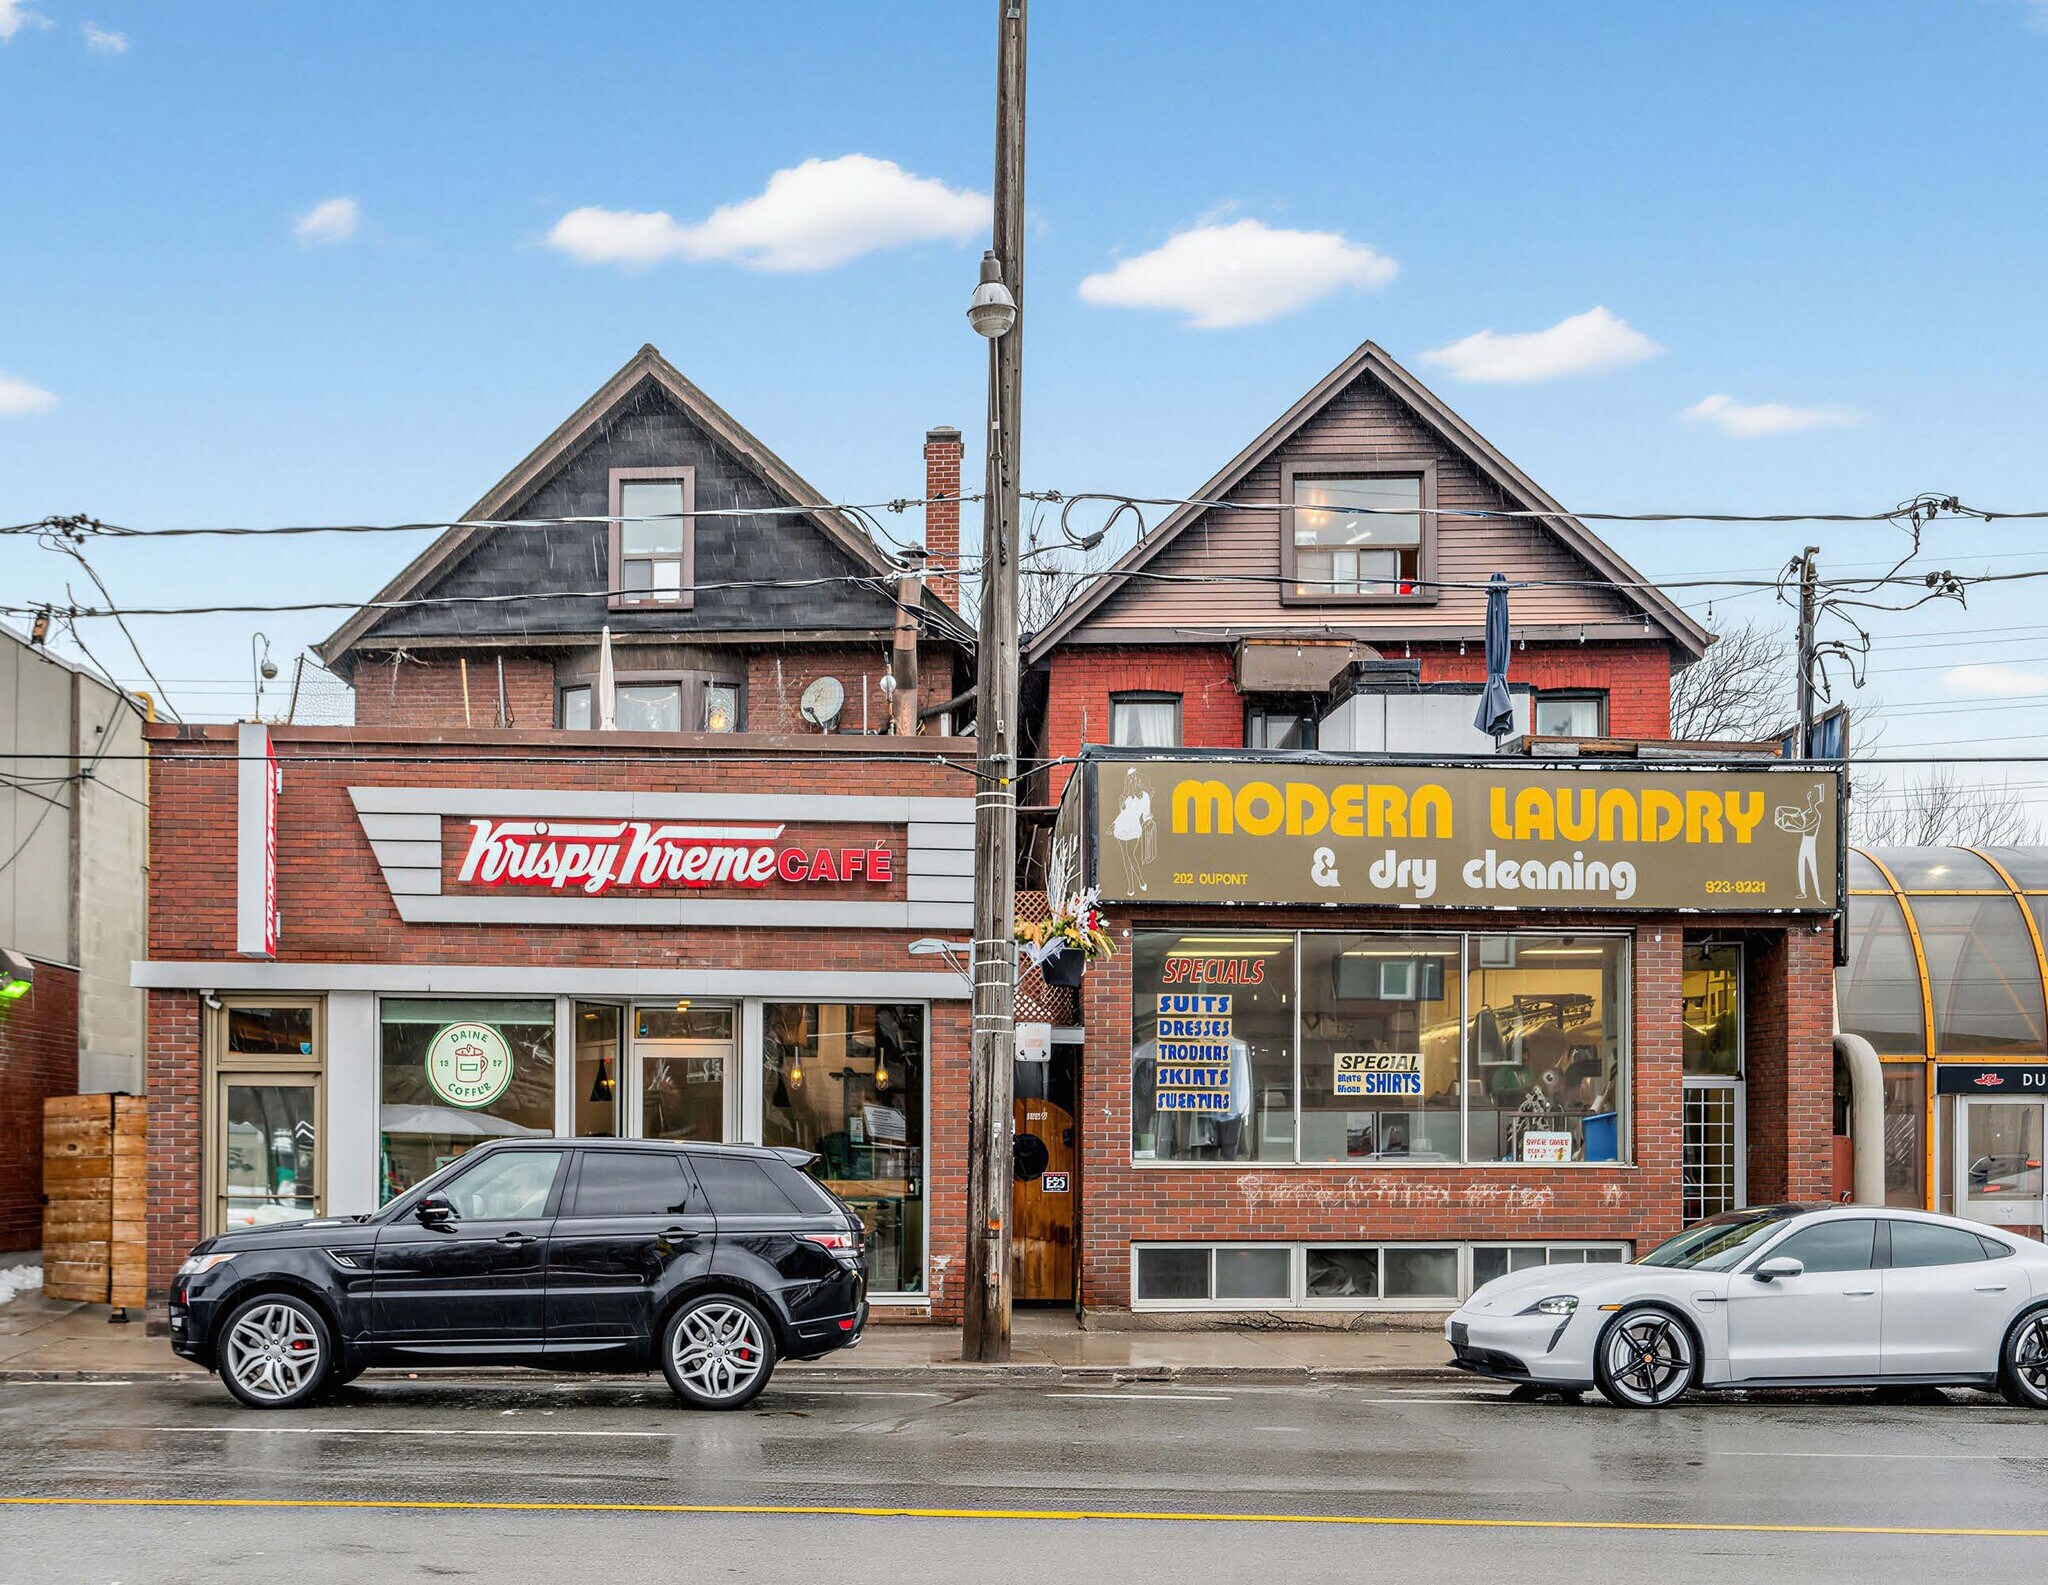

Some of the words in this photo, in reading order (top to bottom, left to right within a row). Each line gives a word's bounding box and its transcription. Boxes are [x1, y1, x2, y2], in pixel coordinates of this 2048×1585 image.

[1172, 779, 1453, 839] MODERN
[1490, 786, 1765, 844] LAUNDRY
[457, 819, 628, 894] Krispy
[618, 821, 786, 885] Kreme
[777, 839, 893, 883] CAFÉ
[1173, 873, 1194, 884] 202
[1310, 847, 1341, 888] &
[1369, 850, 1437, 899] dry
[1462, 850, 1637, 900] cleaning
[1162, 957, 1265, 985] SPECIALS
[1159, 995, 1230, 1013] SUITS
[1159, 1020, 1230, 1037] DRESSES
[1340, 1055, 1419, 1070] SPECIAL
[1365, 1073, 1421, 1093] SHIRTS
[2023, 1073, 2046, 1086] DU
